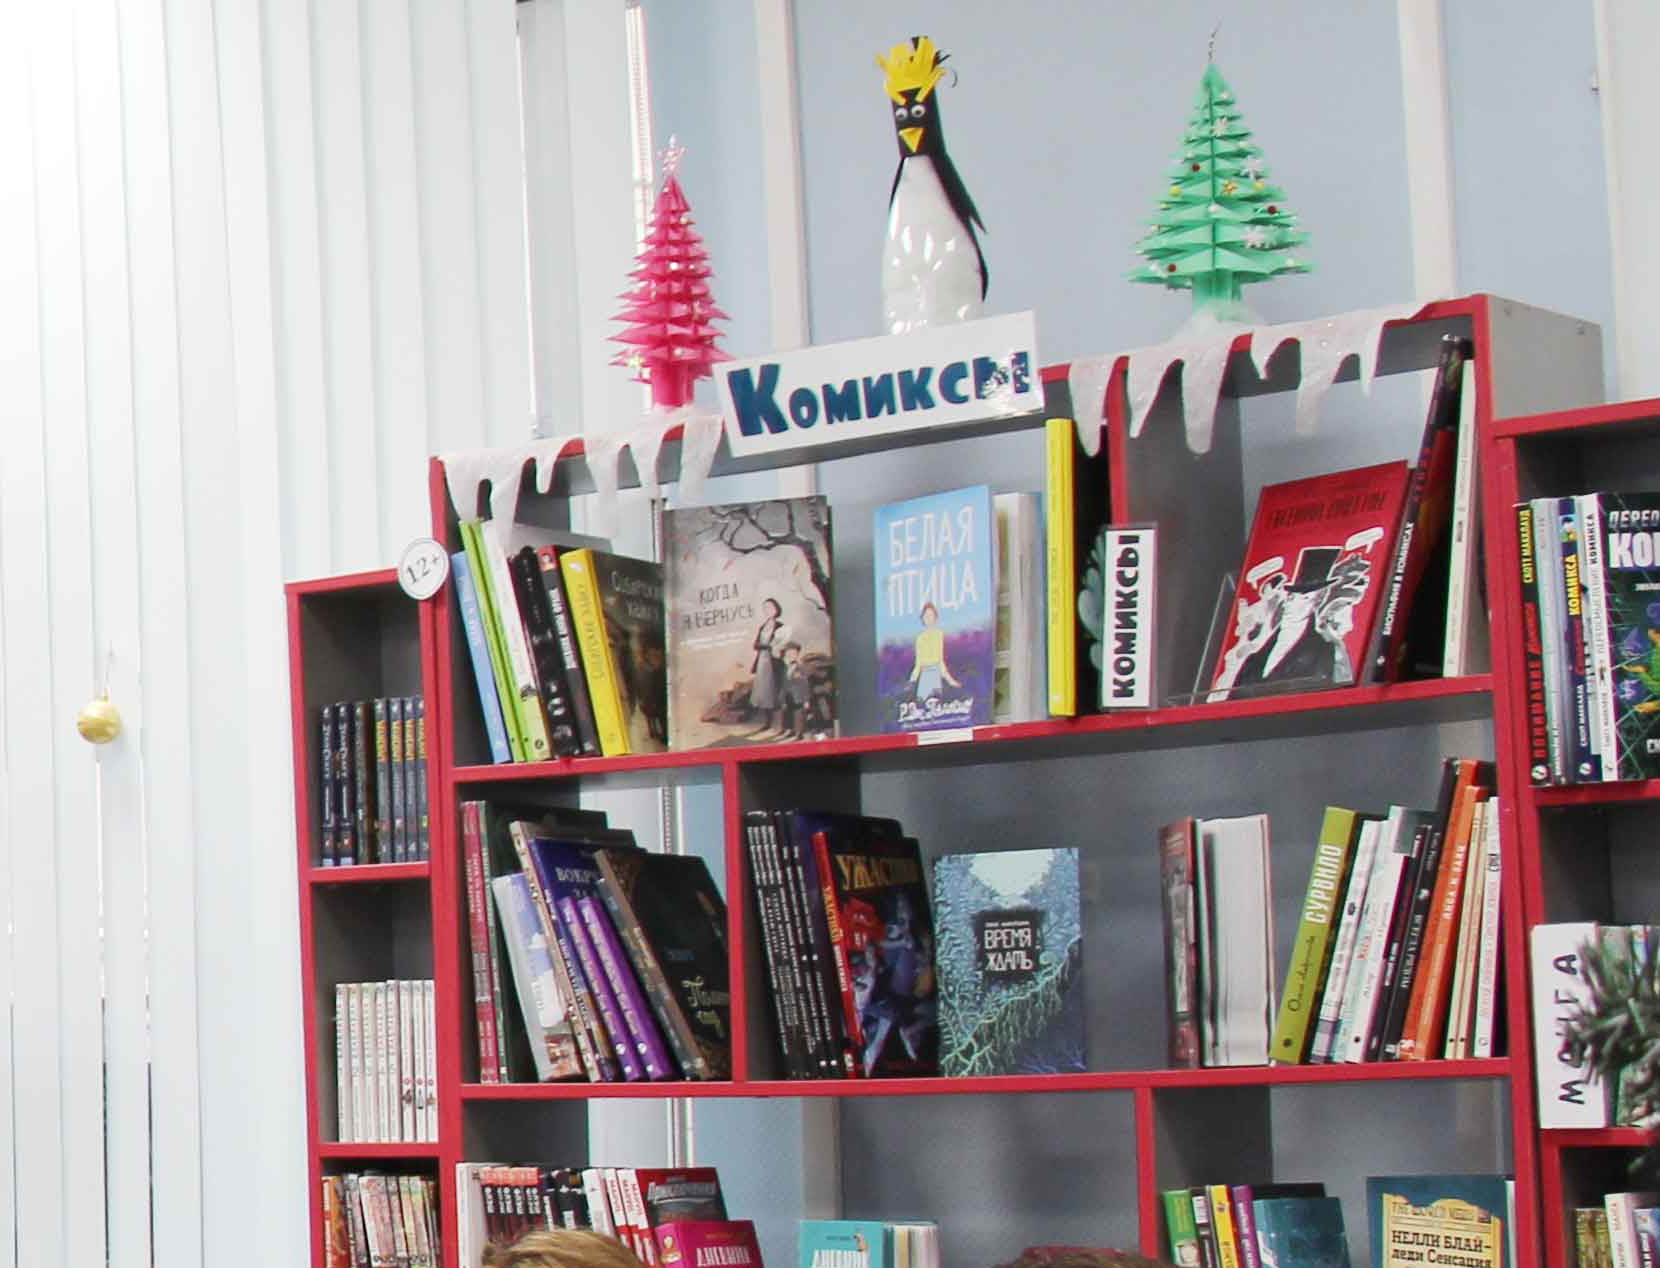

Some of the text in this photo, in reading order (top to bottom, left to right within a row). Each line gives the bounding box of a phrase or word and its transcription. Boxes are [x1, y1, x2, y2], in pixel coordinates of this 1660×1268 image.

[728, 351, 1030, 437] Комиксы
[889, 506, 974, 567] БЕЛАЯ
[699, 583, 739, 605] КОГДА
[888, 560, 977, 616] ПТИЦА
[1565, 554, 1582, 616] КОМИКСА
[1113, 534, 1140, 698] КОМИКСЫ
[1305, 845, 1342, 924] СУРВИЛО
[984, 928, 1032, 950] ВРЕМЯ
[985, 951, 1033, 972] ЖДАТЬ
[1391, 1229, 1439, 1249] НЕЛЛИ
[1391, 1245, 1424, 1264] леди
